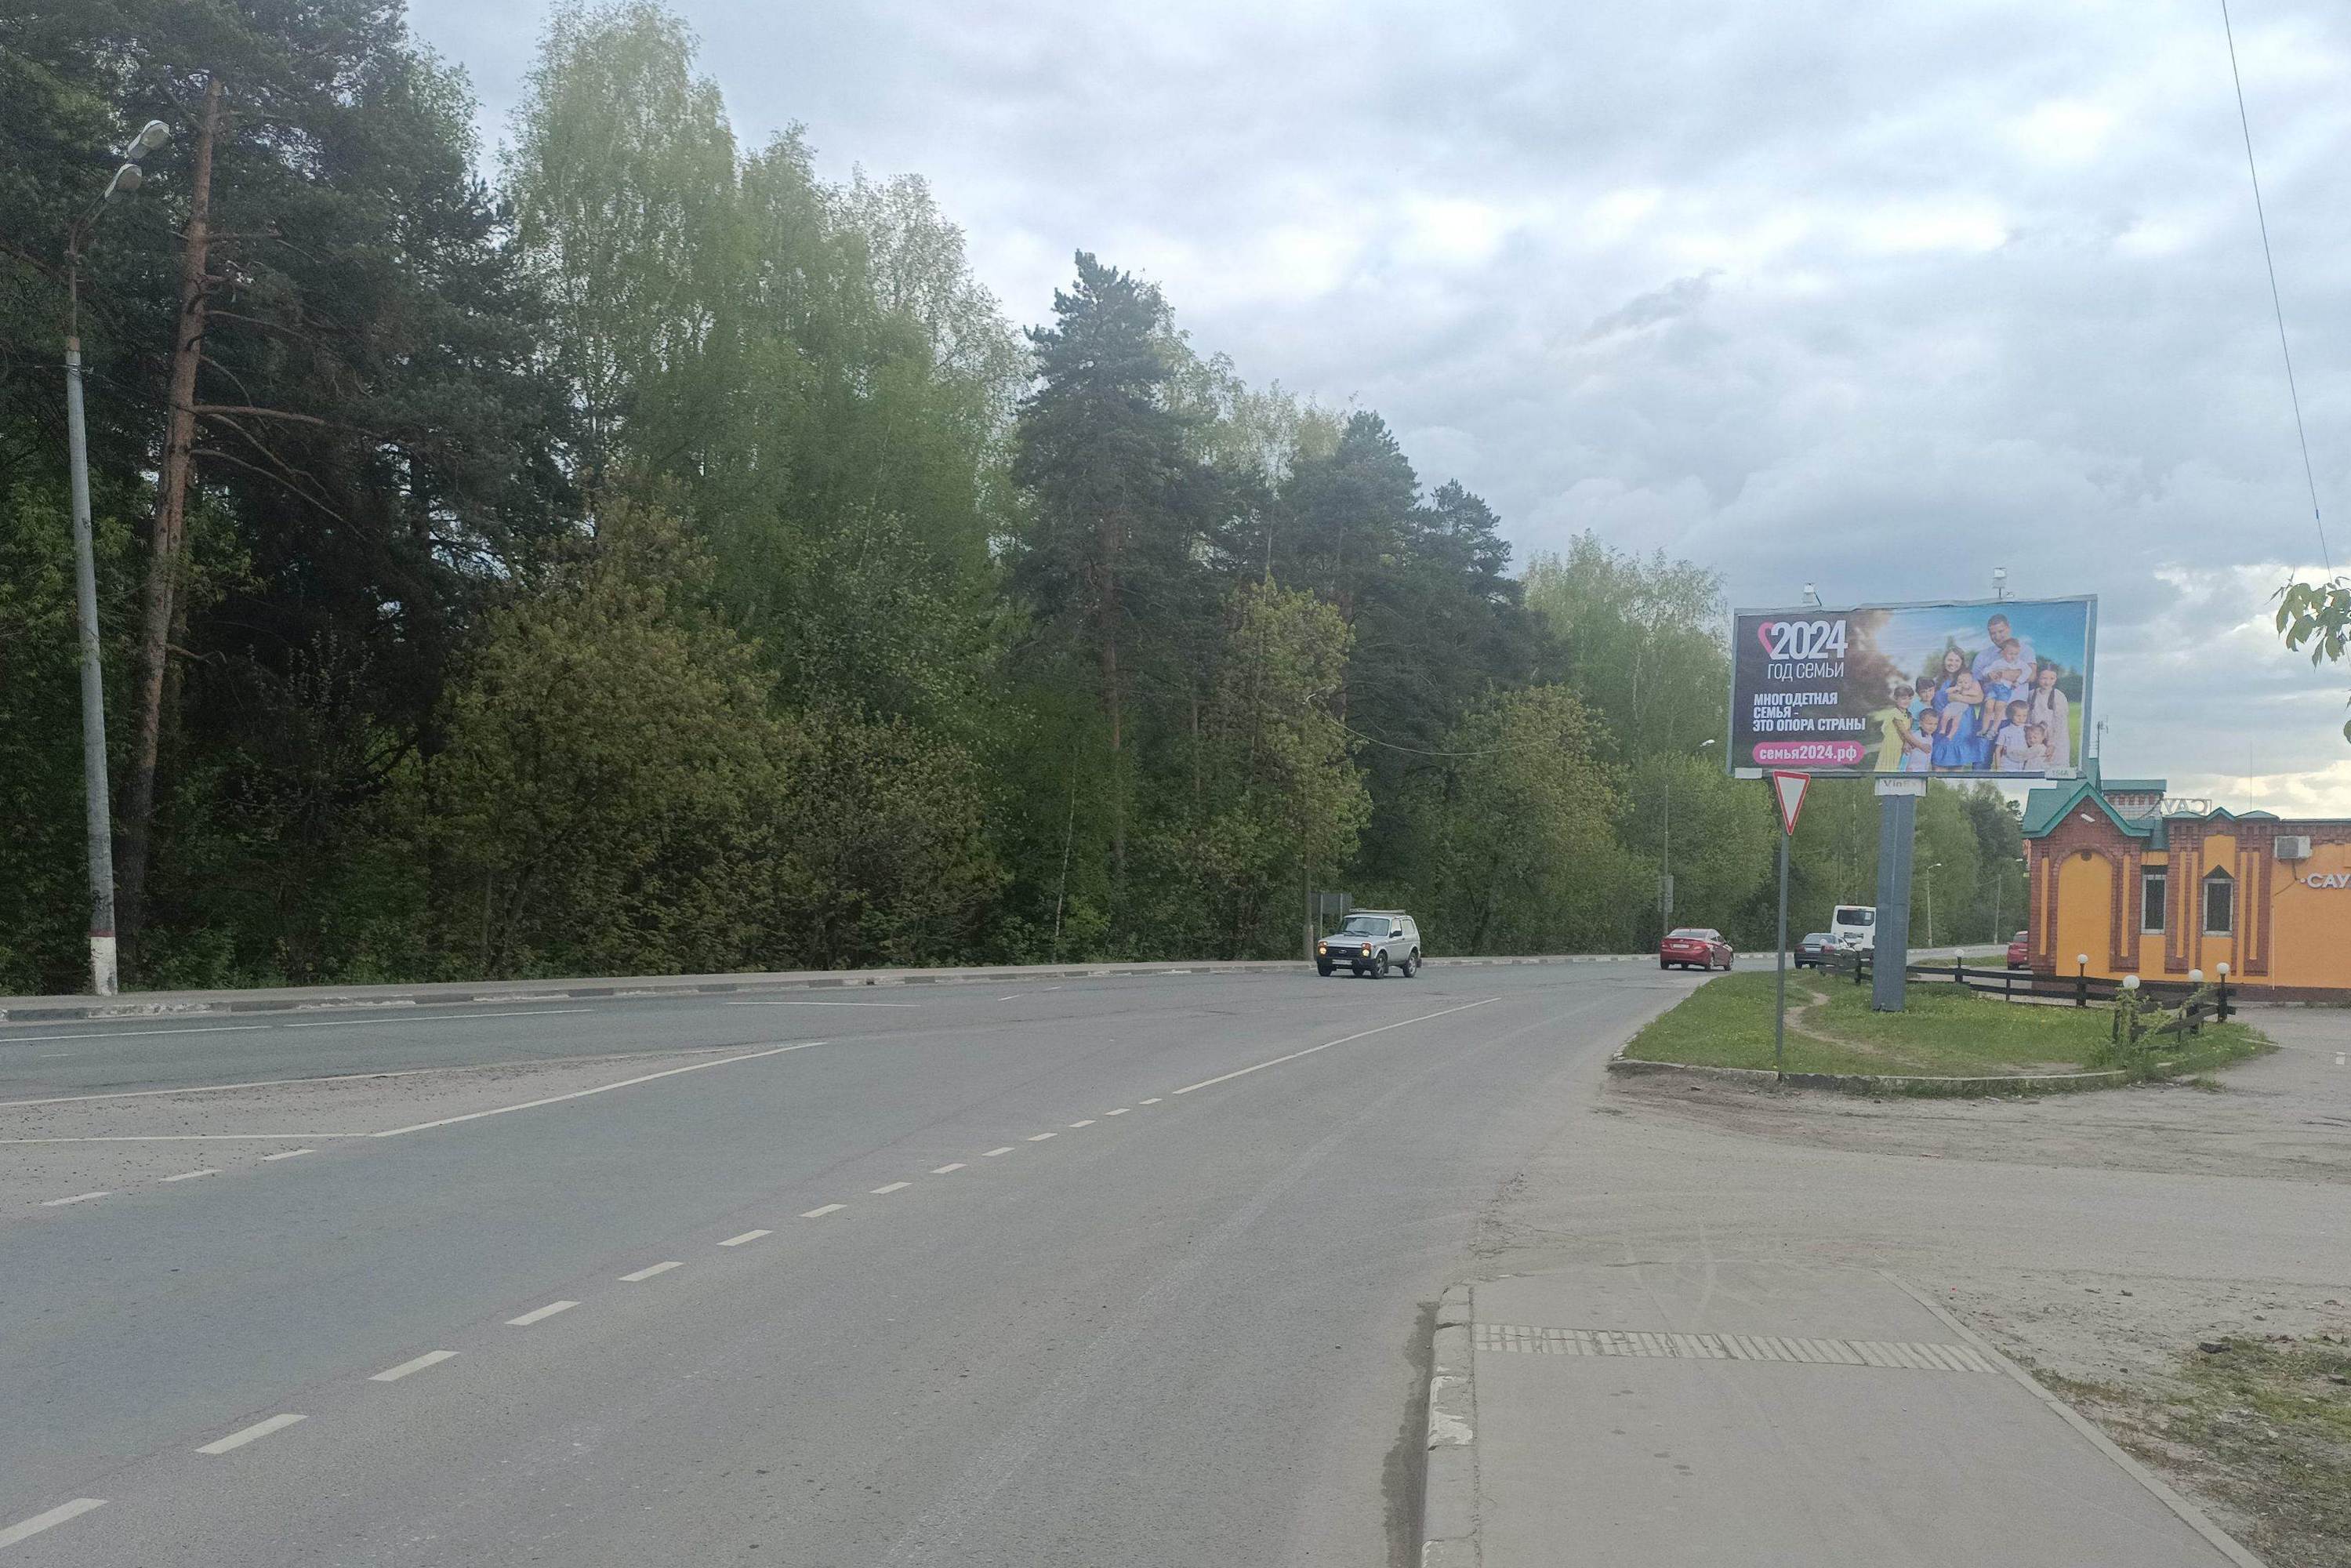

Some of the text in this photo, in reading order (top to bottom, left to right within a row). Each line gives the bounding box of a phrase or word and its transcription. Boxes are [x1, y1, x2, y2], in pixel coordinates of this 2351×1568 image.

[1770, 620, 1848, 659] 2024
[1754, 692, 1838, 706] МНОГОДЕТНАЯ
[1753, 706, 1791, 719] СЕМЬЯ
[1753, 717, 1866, 732] ЭТО ОПОРА СТРАНЫ
[1759, 745, 1857, 762] семья2024.рф
